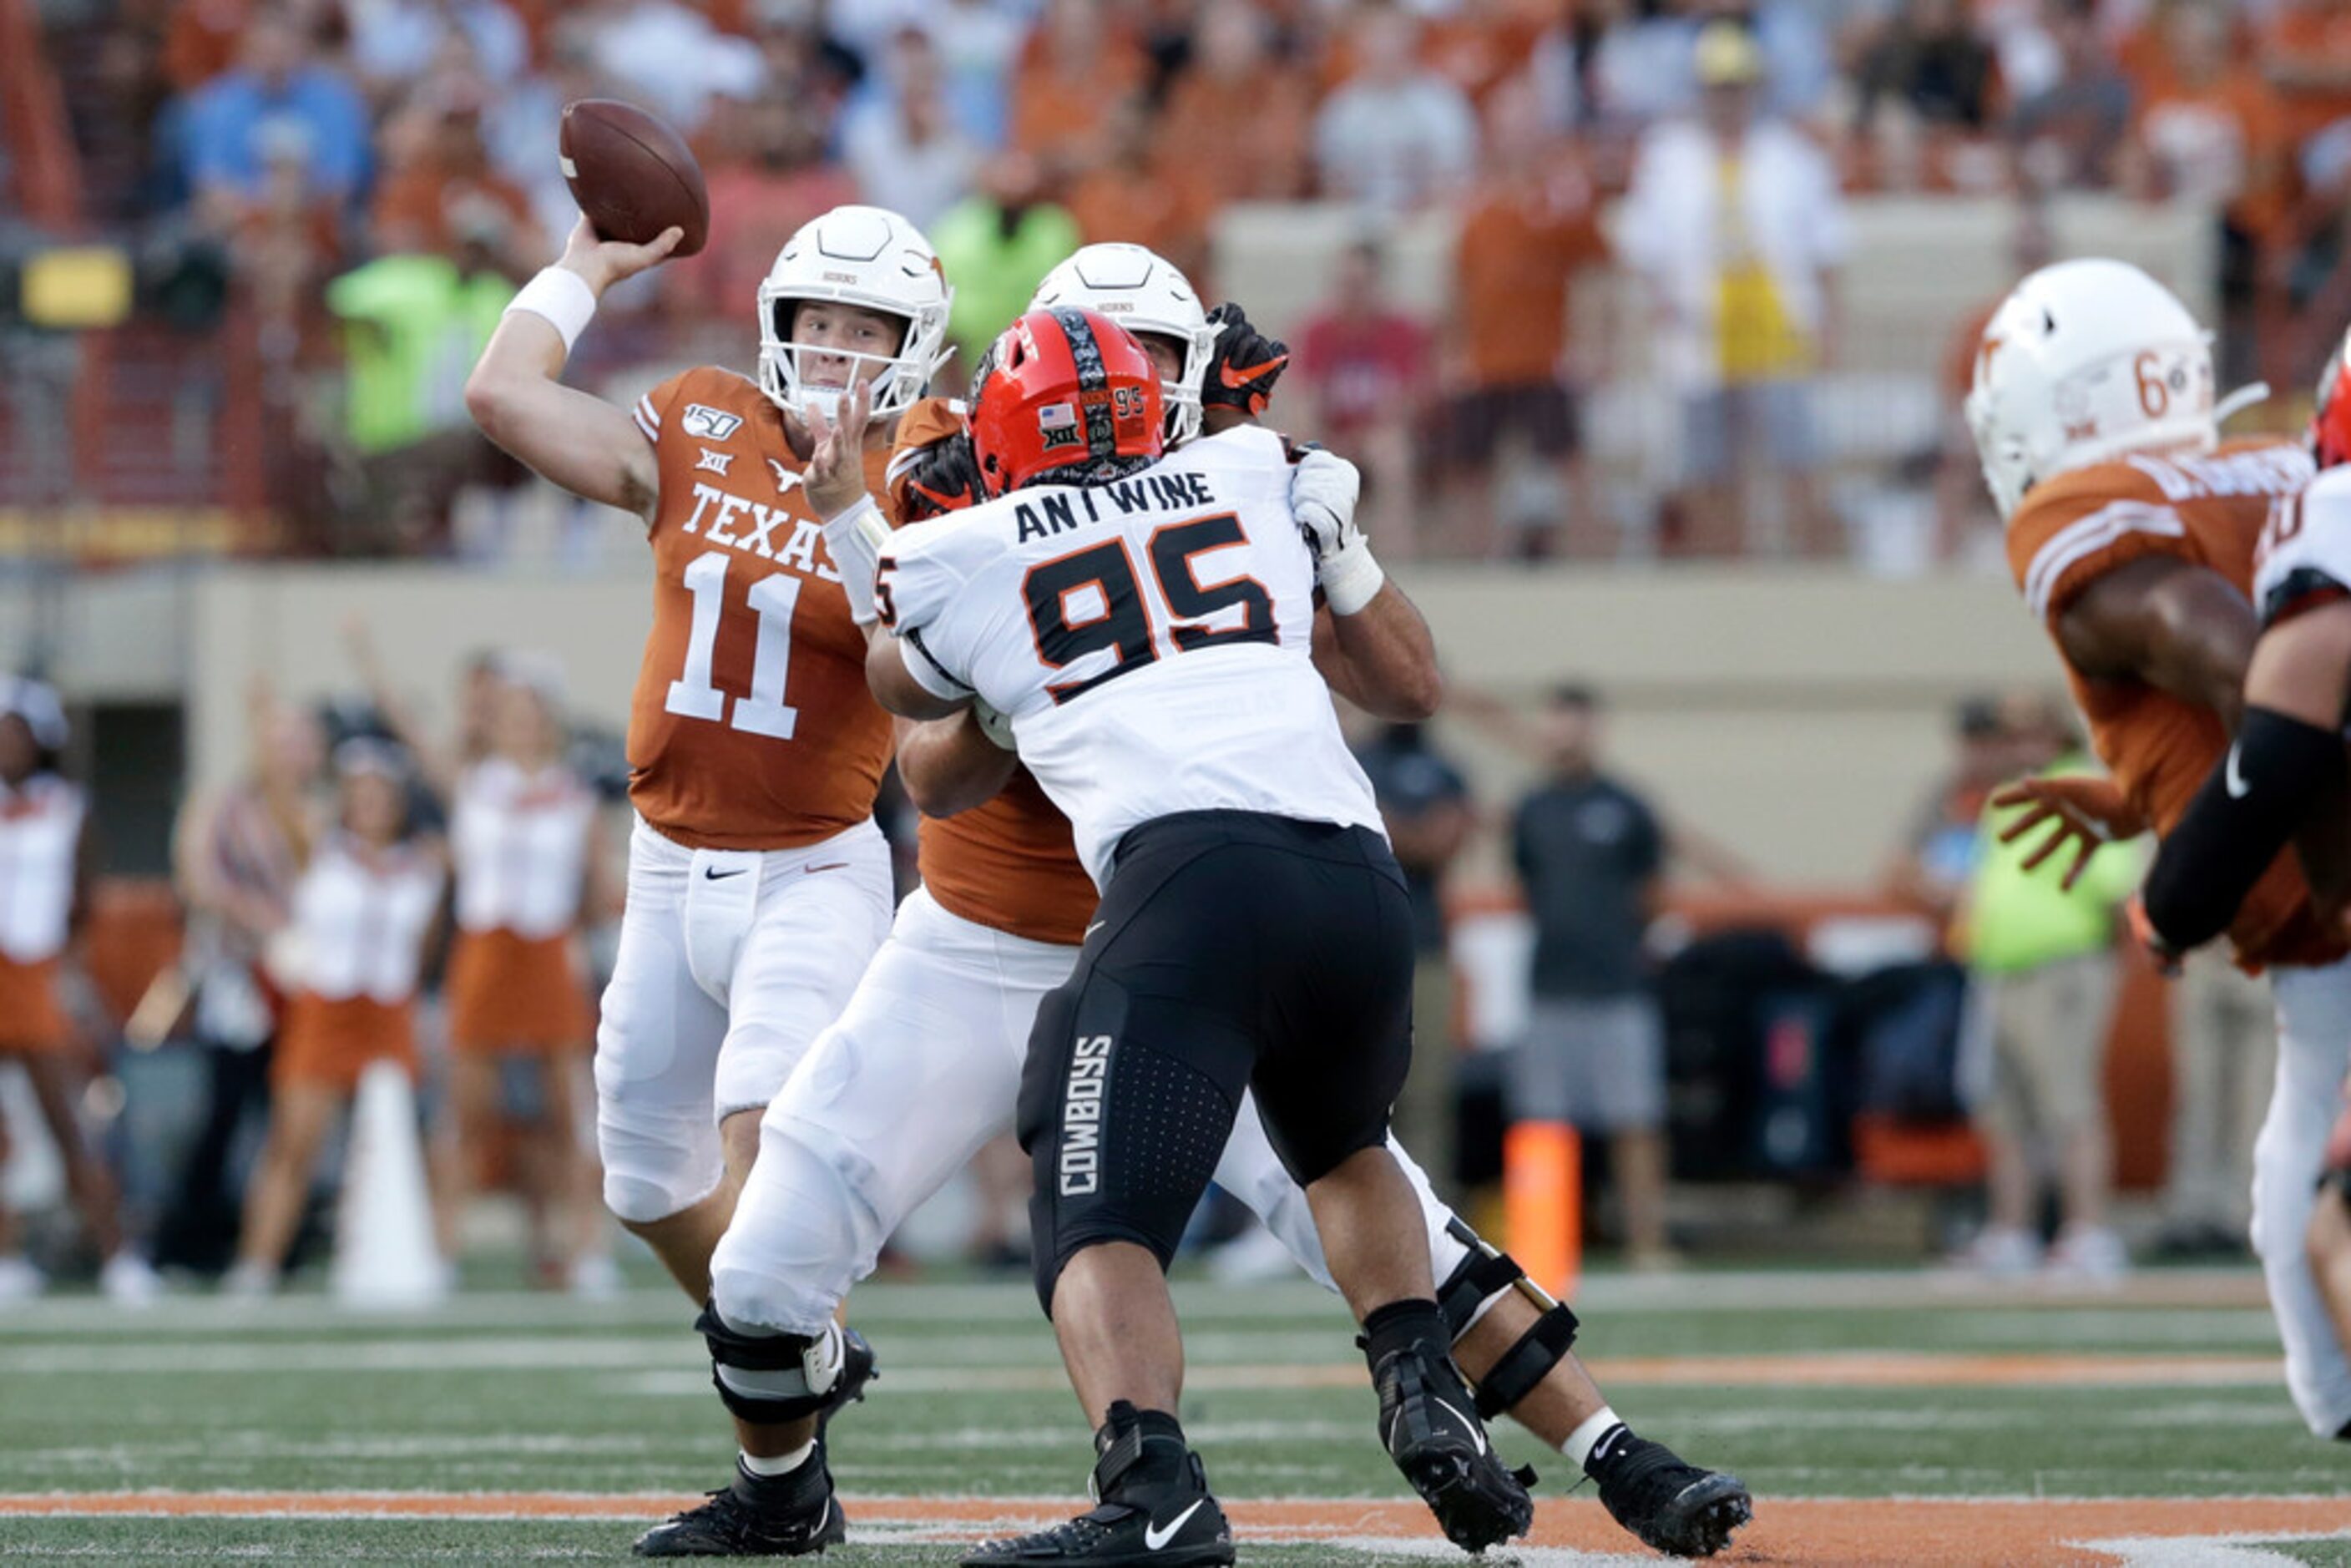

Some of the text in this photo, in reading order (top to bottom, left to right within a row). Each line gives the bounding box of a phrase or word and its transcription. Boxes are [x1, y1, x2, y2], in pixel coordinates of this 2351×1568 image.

[685, 405, 741, 438] 150
[1114, 387, 1145, 418] 95
[665, 549, 802, 741] 11
[1020, 511, 1280, 706] 95
[1060, 1034, 1113, 1196] COWBOYS
